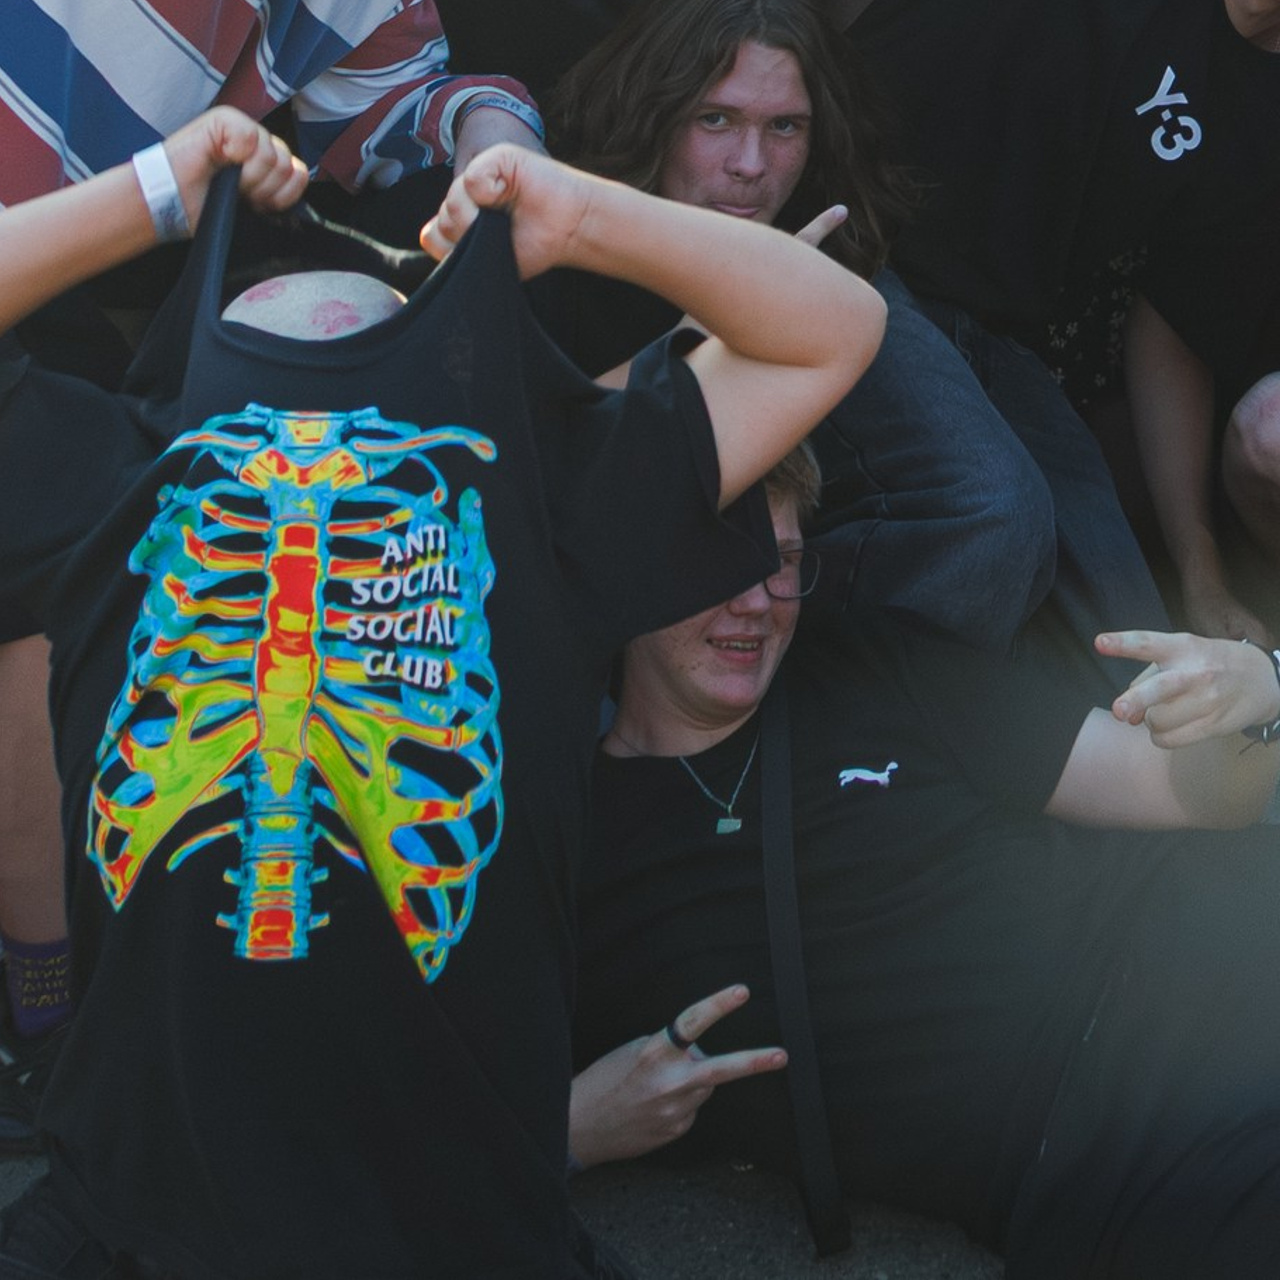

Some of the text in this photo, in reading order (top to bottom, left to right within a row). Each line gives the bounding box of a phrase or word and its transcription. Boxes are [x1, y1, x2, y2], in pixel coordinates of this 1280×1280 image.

[380, 523, 446, 566] ANTI
[351, 564, 460, 605] SOCIAL
[346, 606, 455, 646] SOCIAL
[363, 650, 443, 689] CLUB
